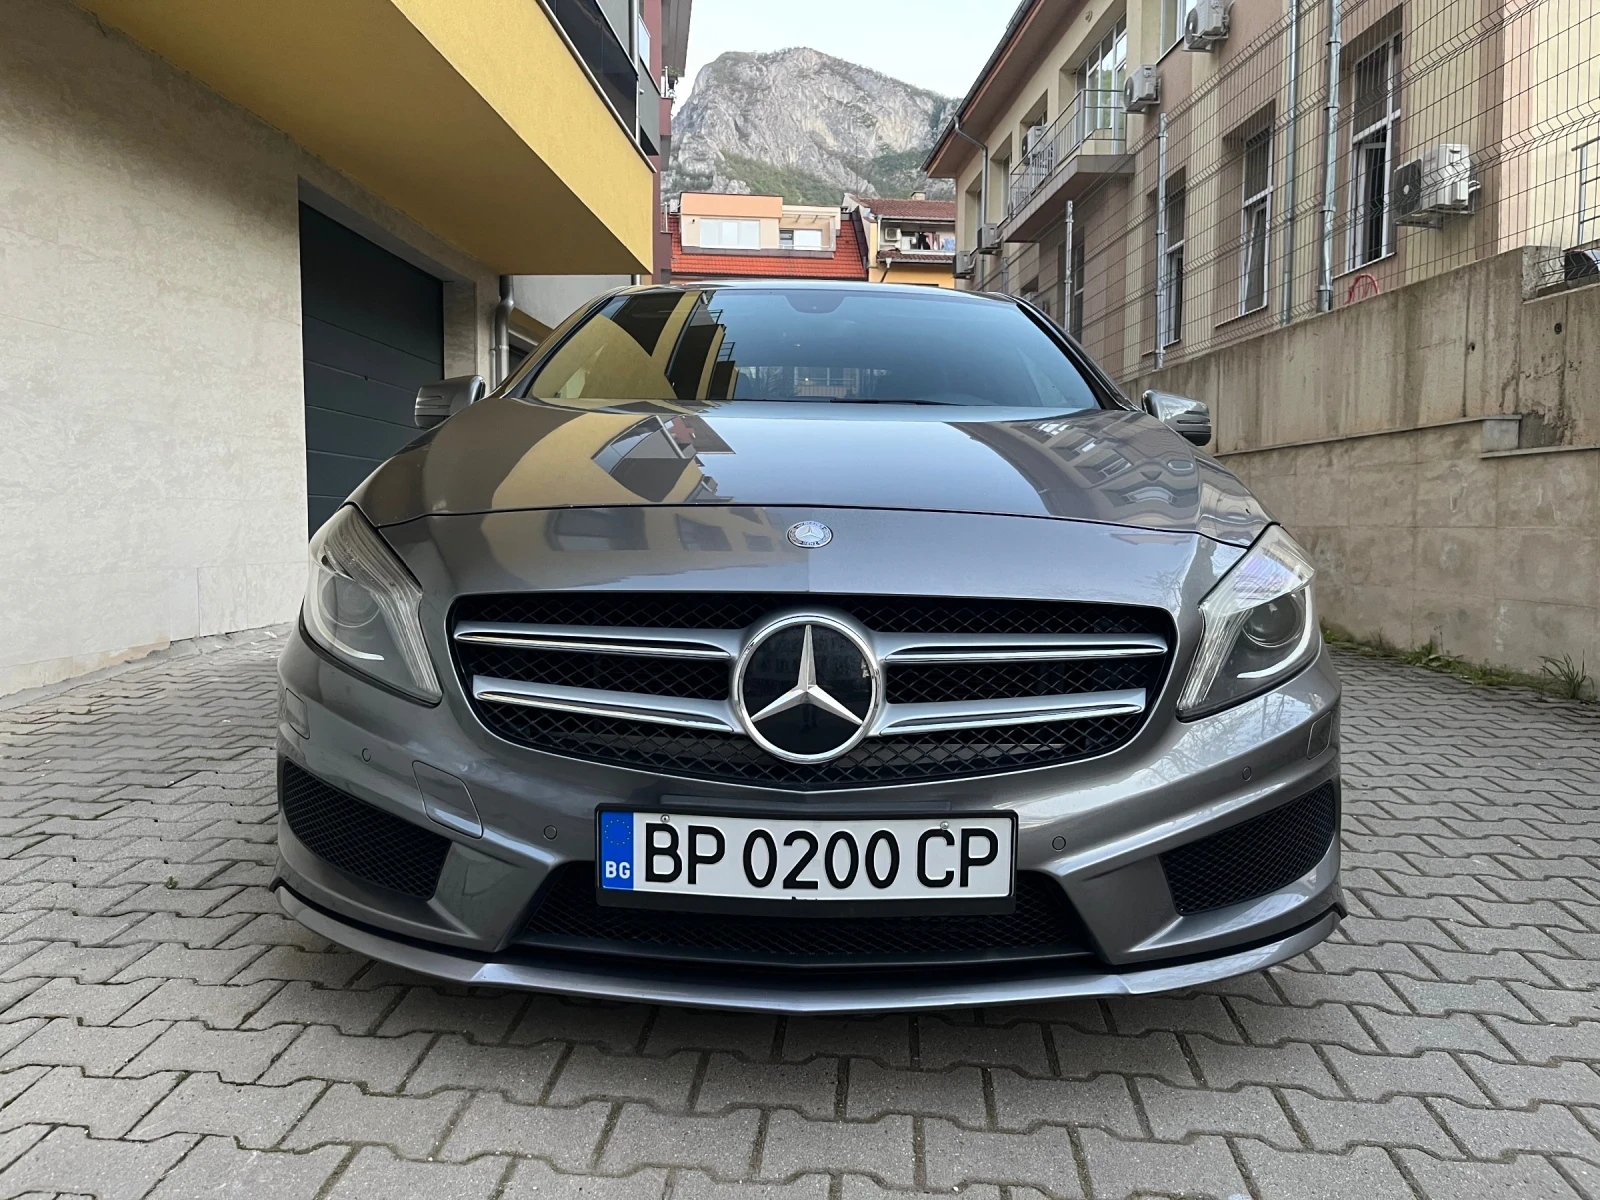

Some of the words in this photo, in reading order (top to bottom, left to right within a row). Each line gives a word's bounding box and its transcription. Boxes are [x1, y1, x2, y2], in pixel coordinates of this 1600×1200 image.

[605, 861, 631, 879] BG
[645, 823, 725, 884] BP
[743, 829, 900, 889] 0200
[917, 828, 998, 888] CP
